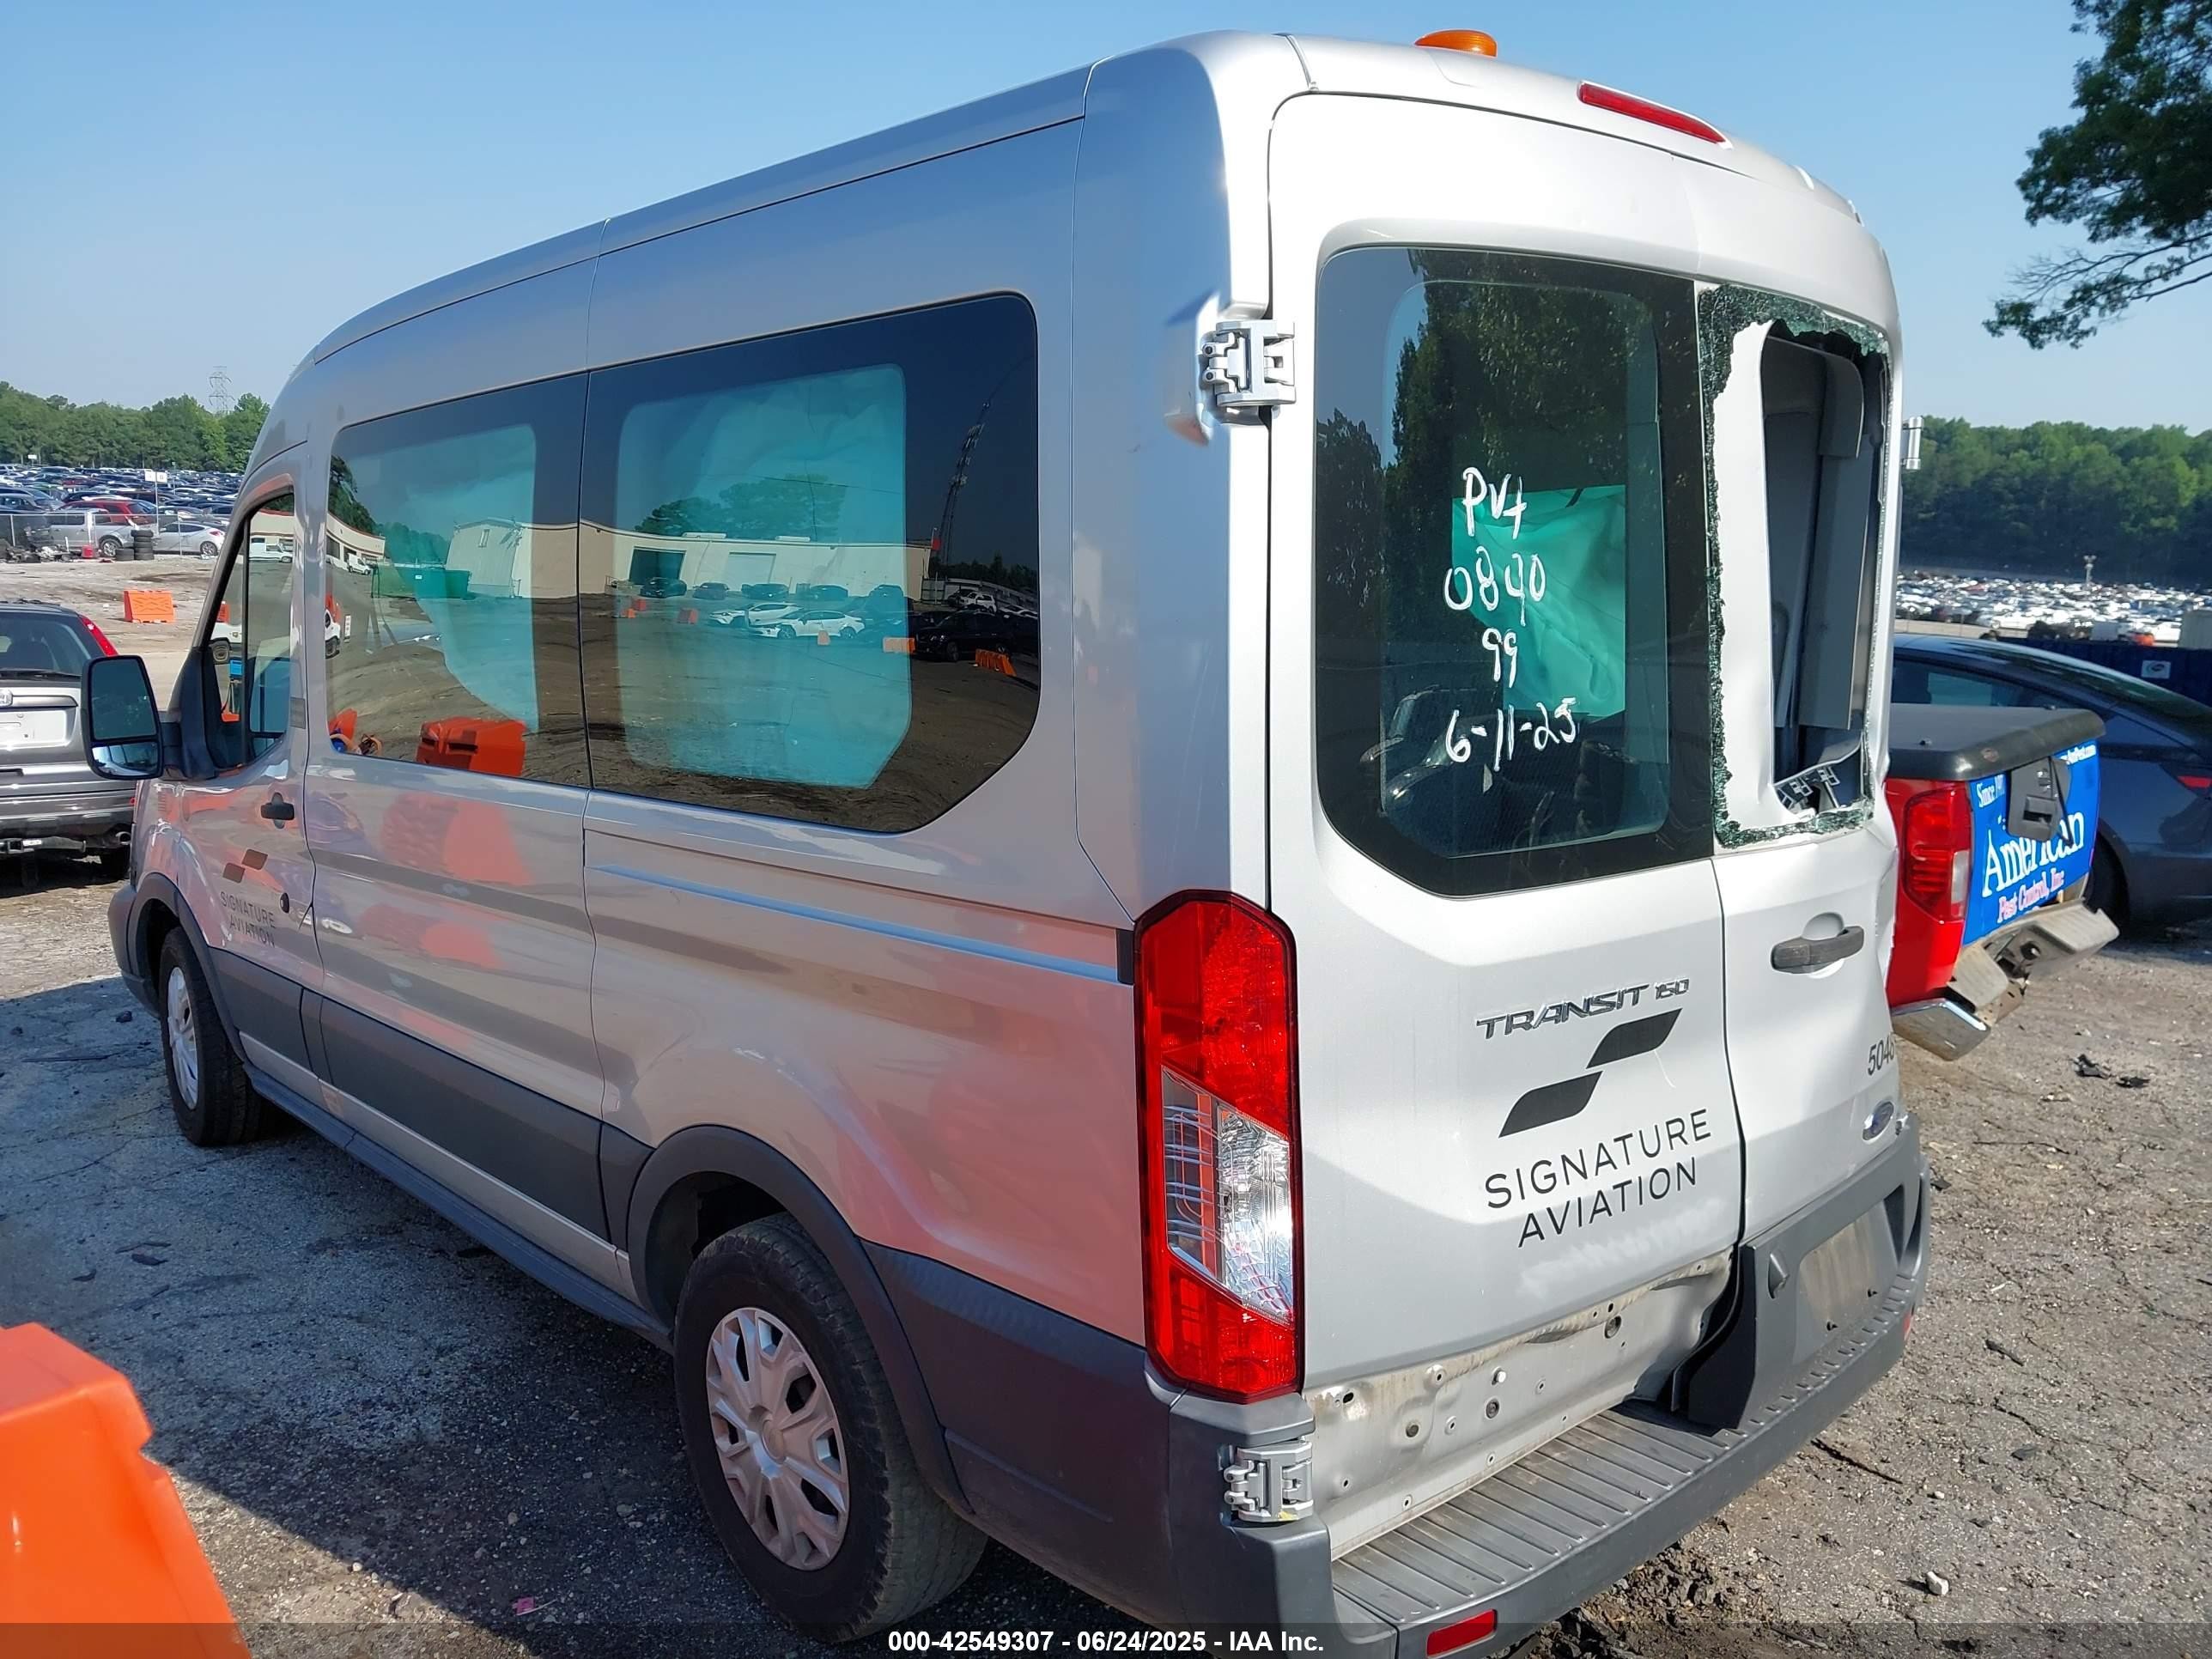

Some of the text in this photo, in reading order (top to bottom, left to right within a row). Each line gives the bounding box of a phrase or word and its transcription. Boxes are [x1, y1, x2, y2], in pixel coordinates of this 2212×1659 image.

[1482, 628, 1518, 688] 99
[1445, 696, 1578, 772] 6-11-25
[220, 891, 276, 928] SIGNATURE
[229, 914, 276, 948] AVIATION
[1476, 984, 1650, 1040] TRANSIT
[1485, 1108, 1711, 1209] SIGNATURE
[1518, 1156, 1697, 1249] AVIATION
